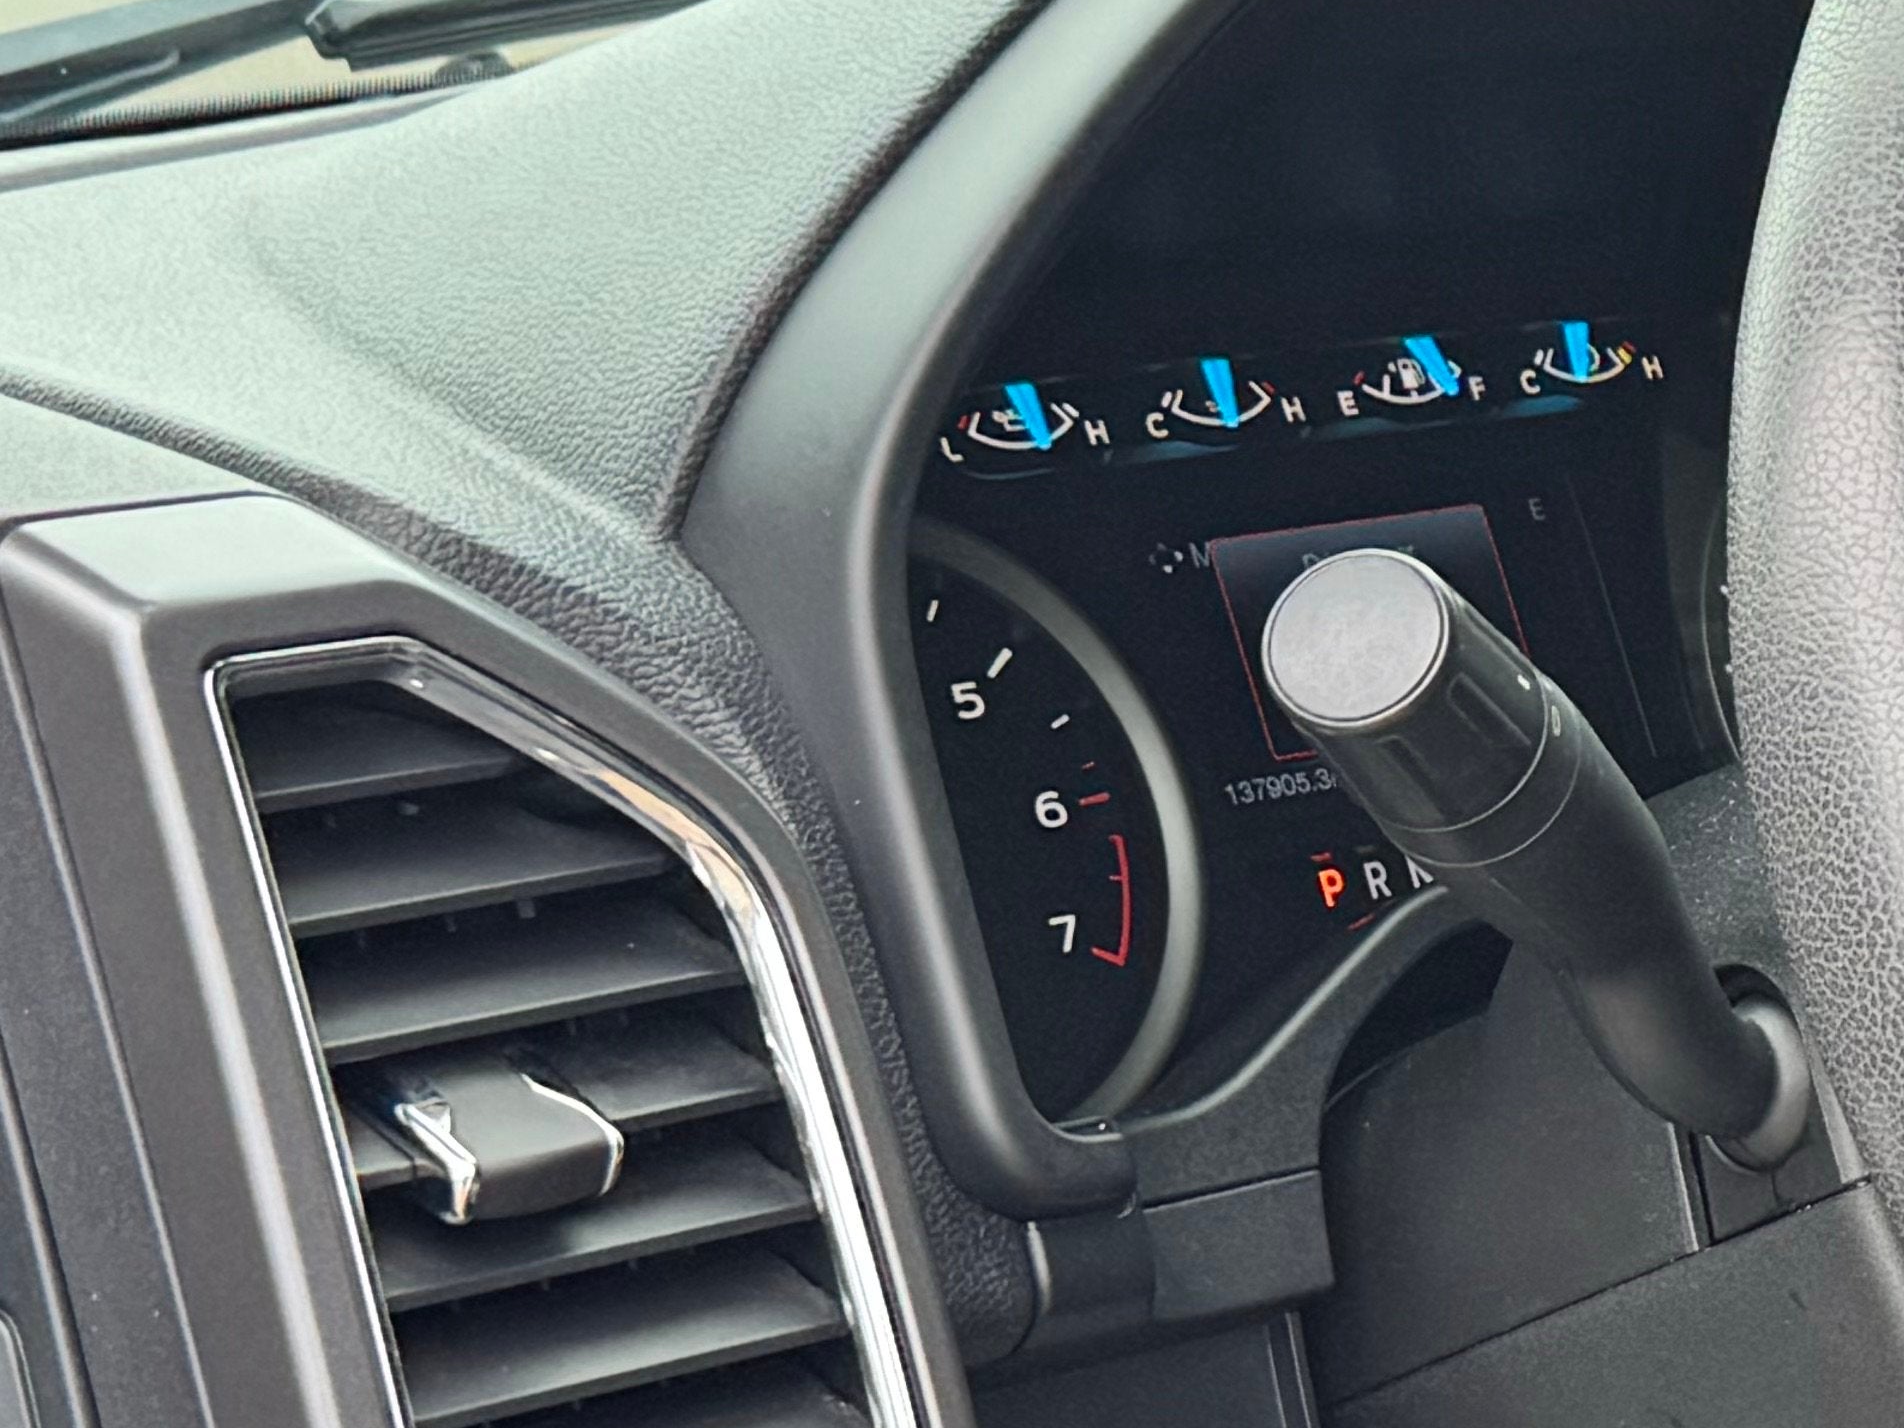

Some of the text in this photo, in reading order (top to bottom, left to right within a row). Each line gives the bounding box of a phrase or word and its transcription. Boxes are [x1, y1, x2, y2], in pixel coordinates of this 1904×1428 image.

[1520, 355, 1664, 395] C H
[1337, 376, 1485, 416] E F
[1146, 397, 1306, 438] C H
[941, 420, 1110, 462] L H
[950, 681, 985, 719] 5
[1224, 768, 1336, 805] 137905.3
[1034, 790, 1068, 828] 6
[1318, 868, 1344, 907] P
[1363, 861, 1392, 899] R
[1048, 914, 1076, 953] 7
